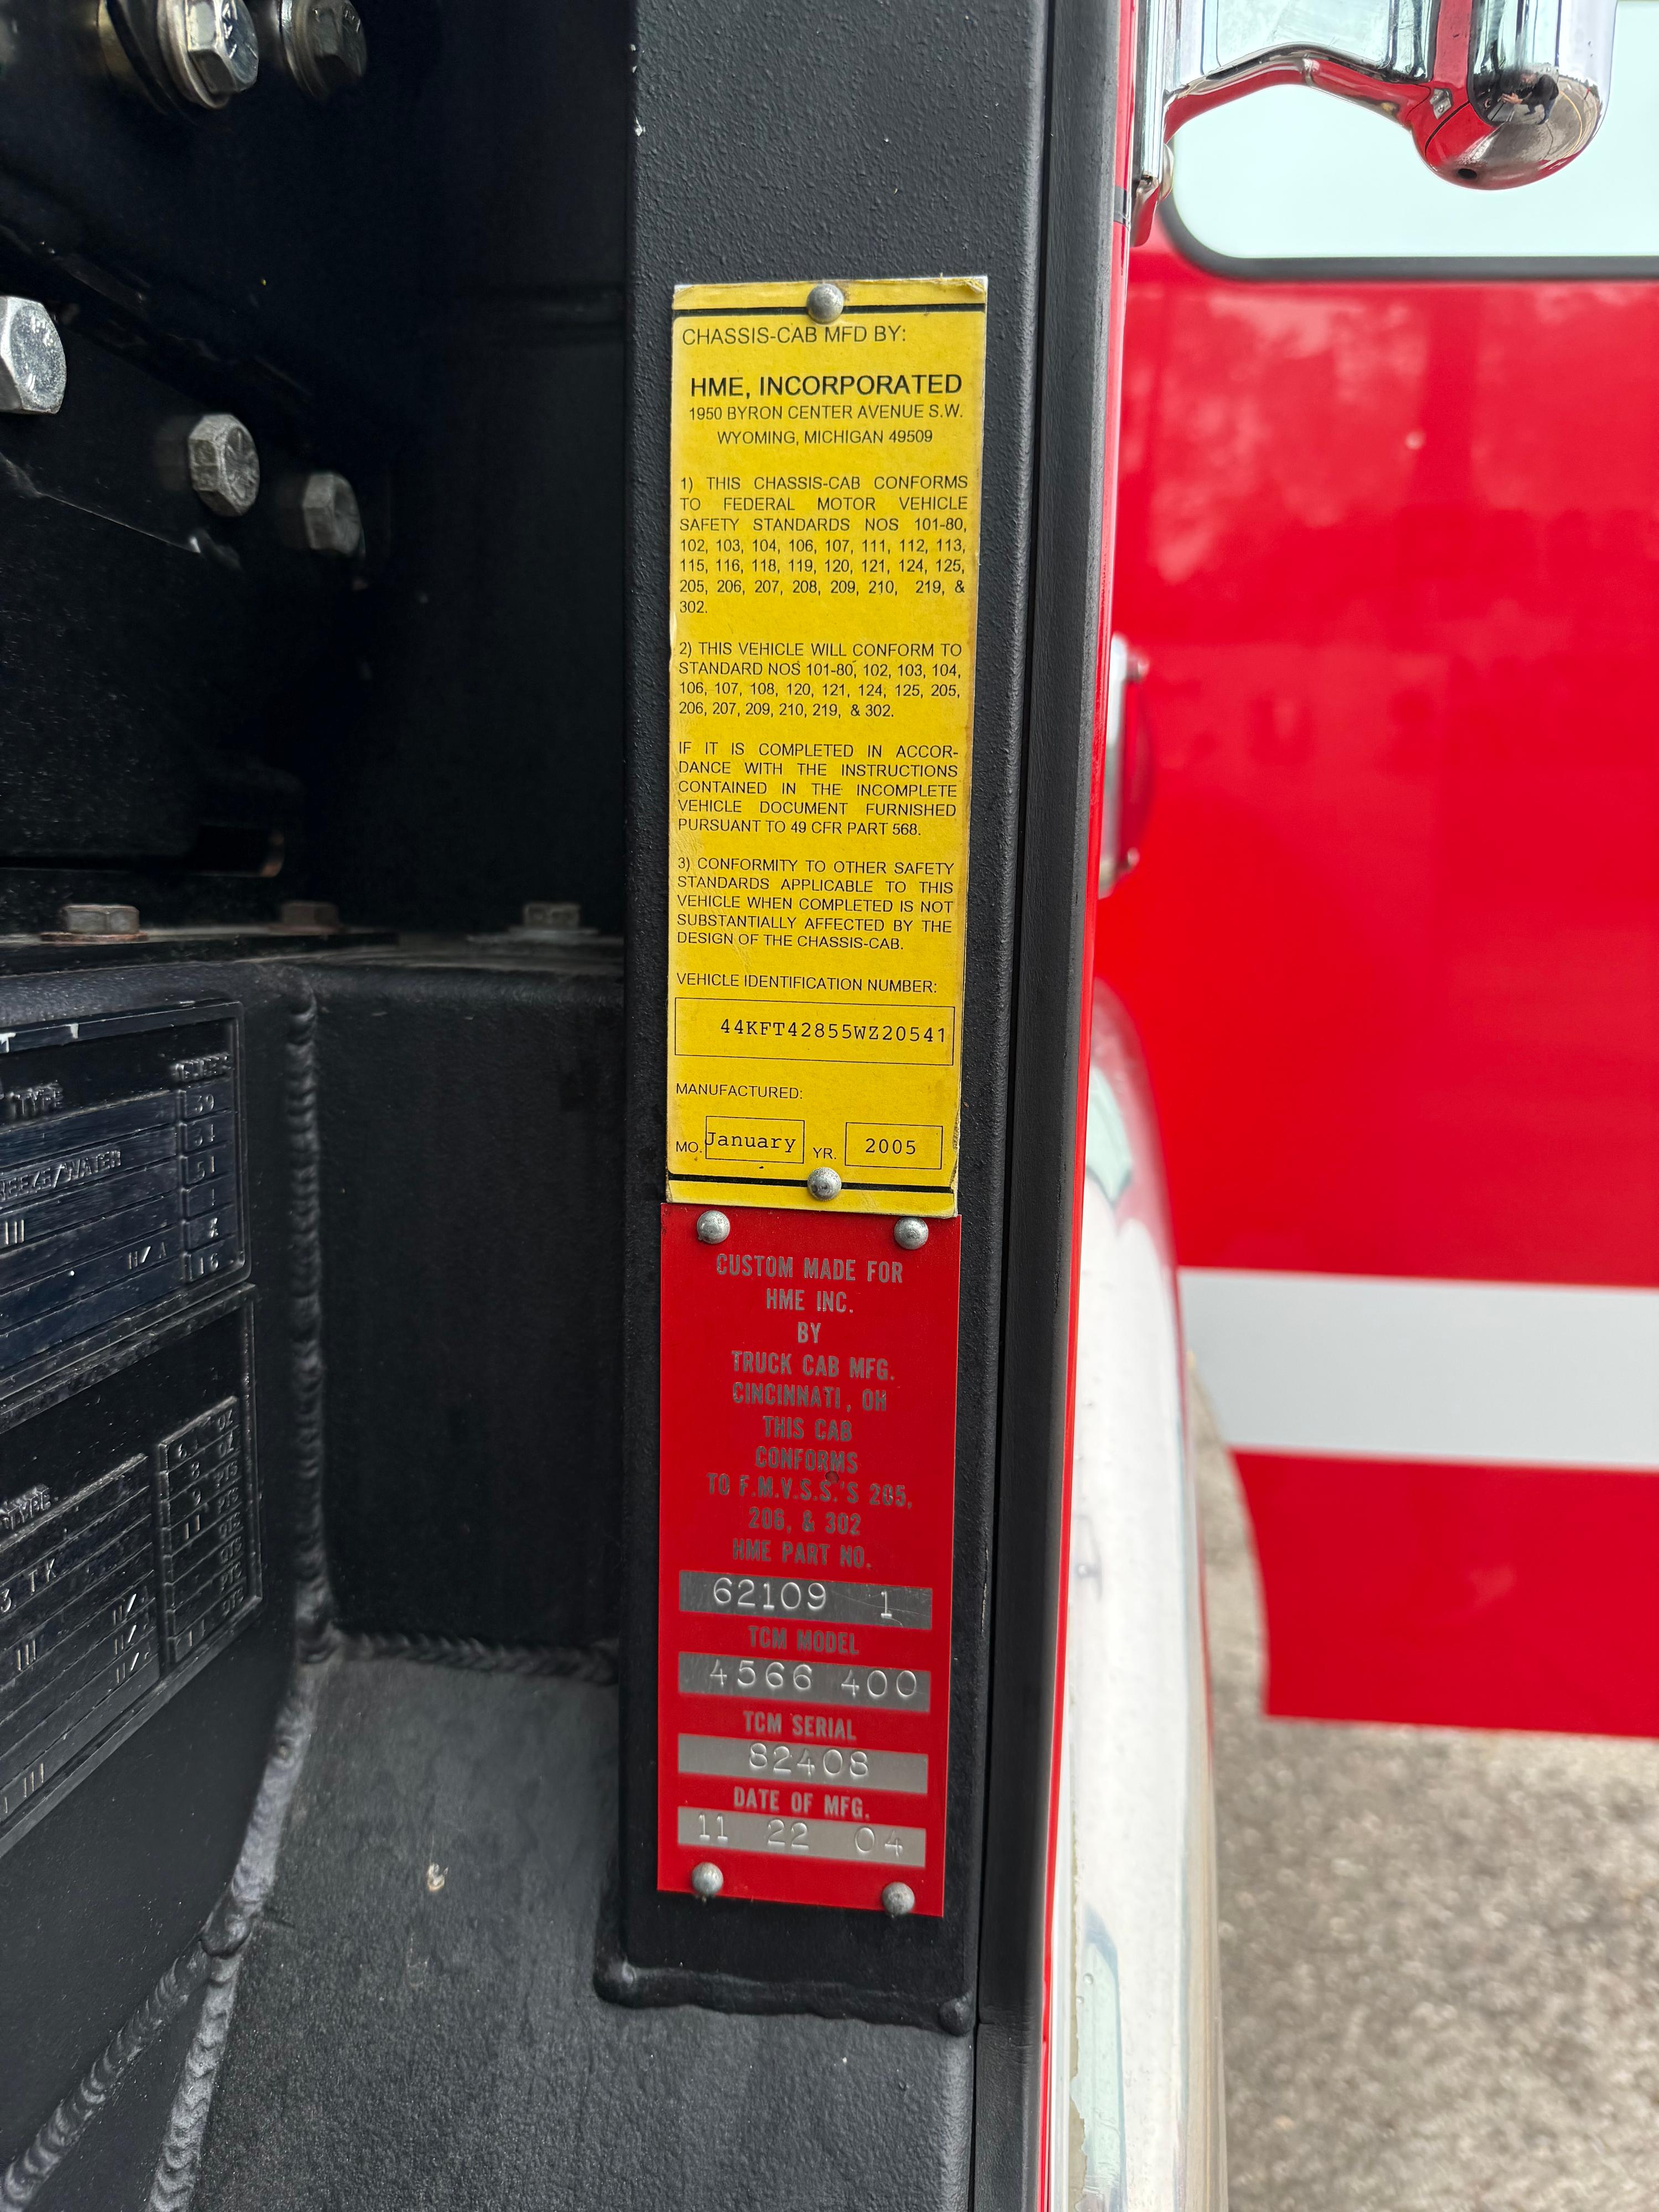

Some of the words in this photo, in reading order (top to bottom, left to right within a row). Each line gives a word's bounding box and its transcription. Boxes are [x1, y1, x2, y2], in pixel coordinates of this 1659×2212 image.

[682, 326, 817, 346] CHASSIS-CAB
[825, 326, 867, 343] MFD
[874, 325, 906, 342] BY:
[691, 377, 750, 399] HME,
[760, 374, 962, 397] INCORPORATED
[689, 406, 722, 421] 1950
[727, 405, 782, 420] BYRON
[788, 405, 853, 419] CENTER
[857, 404, 924, 419] AVENUE
[928, 403, 963, 418] S.W.
[717, 430, 799, 446] WYOMING,
[804, 430, 883, 444] MICHIGAN
[889, 429, 933, 443] 49509
[681, 476, 693, 493] 1)
[706, 476, 741, 491] THIS
[754, 476, 860, 490] CHASSIS-CAB
[874, 475, 968, 489] CONFORMS
[680, 497, 701, 511] TO
[724, 497, 796, 511] FEDERAL
[817, 497, 876, 511] MOTOR
[899, 495, 968, 510] VEHICLE
[680, 518, 739, 531] SAFETY
[753, 518, 850, 531] STANDARDS
[865, 518, 899, 531] NOS
[915, 517, 967, 533] 101-80,
[681, 539, 708, 555] 102,
[716, 539, 744, 555] 103,
[752, 539, 780, 555] 104,
[789, 539, 817, 555] 106,
[825, 539, 853, 555] 107,
[862, 539, 890, 555] 111,
[899, 539, 928, 555] 112,
[936, 538, 966, 554] 113,
[680, 600, 708, 614] 302.
[679, 641, 692, 659] 2)
[698, 641, 732, 655] THIS
[738, 642, 804, 656] VEHICLE
[811, 643, 847, 657] WILL
[853, 643, 934, 657] CONFORM
[940, 643, 962, 657] TO
[679, 661, 763, 675] STANDARD
[768, 662, 801, 676] NOS
[806, 663, 857, 679] 101-80,
[863, 663, 891, 680] 102,
[898, 663, 926, 679] 103,
[932, 663, 961, 679] 104,
[679, 701, 707, 717] 206,
[712, 702, 740, 717] 207,
[745, 702, 774, 718] 209,
[779, 703, 807, 718] 210,
[812, 703, 841, 719] 219,
[850, 703, 860, 717] &
[865, 703, 894, 717] 302.
[679, 741, 692, 754] IF
[705, 742, 719, 755] IT
[731, 742, 745, 755] IS
[759, 743, 854, 758] COMPLETED
[868, 744, 882, 758] IN
[895, 744, 959, 759] ACCOR-
[679, 760, 731, 774] DANCE
[744, 761, 782, 775] WITH
[796, 763, 827, 776] THE
[842, 764, 958, 778] INSTRUCTIONS
[677, 799, 742, 813] VEHICLE
[760, 801, 849, 815] DOCUMENT
[866, 803, 956, 817] FURNISHED
[679, 818, 761, 832] PURSUANT
[765, 820, 786, 833] TO
[790, 821, 807, 833] 49
[811, 821, 842, 834] CFR
[847, 822, 889, 836] PART
[892, 823, 921, 836] 568.
[678, 857, 690, 872] 3)
[697, 857, 798, 872] CONFORMITY
[805, 859, 826, 873] TO
[833, 860, 887, 874] OTHER
[894, 862, 954, 875] SAFETY
[677, 894, 740, 909] VEHICLE
[747, 896, 792, 910] WHEN
[799, 898, 893, 912] COMPLETED
[900, 900, 914, 912] IS
[921, 900, 954, 914] NOT
[677, 914, 797, 929] SUBSTANTIALLY
[804, 917, 885, 932] AFFECTED
[893, 919, 914, 932] BY
[921, 920, 952, 933] THE
[677, 931, 733, 945] DESIGN
[738, 933, 759, 946] OF
[763, 934, 793, 947] THE
[797, 935, 904, 950] CHASSIS-CAB.
[676, 972, 739, 987] VEHICLE
[744, 974, 862, 991] IDENTIFICATION
[868, 979, 937, 993] NUMBER:
[720, 1018, 945, 1043] 44KFT42855WZ20541
[676, 1083, 802, 1099] MANUFACTURED:
[676, 1141, 702, 1153] MO.
[705, 1131, 796, 1153] January
[812, 1147, 837, 1160] YR.
[865, 1138, 916, 1155] 2005
[716, 1253, 793, 1278] CUSTOM
[804, 1257, 856, 1281] MADE
[867, 1260, 903, 1284] FOR
[766, 1287, 805, 1311] HME
[816, 1290, 853, 1313] INC.
[797, 1321, 822, 1344] BY
[731, 1350, 792, 1375] TRUCK
[802, 1354, 839, 1378] CAB
[849, 1357, 894, 1381] MFG.
[862, 1388, 886, 1411] OH
[762, 1415, 804, 1439] THIS
[815, 1418, 852, 1442] CAB
[755, 1446, 858, 1474] CONFORMS
[708, 1473, 730, 1495] TO
[869, 1483, 912, 1509] 205,
[749, 1506, 791, 1532] 206,
[802, 1510, 815, 1532] &
[825, 1512, 861, 1536] 302
[733, 1538, 771, 1562] HME
[782, 1541, 829, 1566] PART
[840, 1545, 871, 1568] NO.
[713, 1577, 827, 1612] 62109
[749, 1625, 787, 1649] TCM
[797, 1630, 859, 1655] MODEL
[709, 1659, 812, 1691] 4566
[841, 1669, 917, 1700] 400
[743, 1710, 782, 1735] TCM
[792, 1714, 857, 1741] SERIAL
[749, 1743, 868, 1778] 82408
[733, 1786, 780, 1812] DATE
[790, 1791, 813, 1815] OF
[823, 1794, 870, 1820] MFG.
[698, 1814, 728, 1843] 11
[768, 1819, 809, 1850] 22
[855, 1827, 903, 1856] 04
